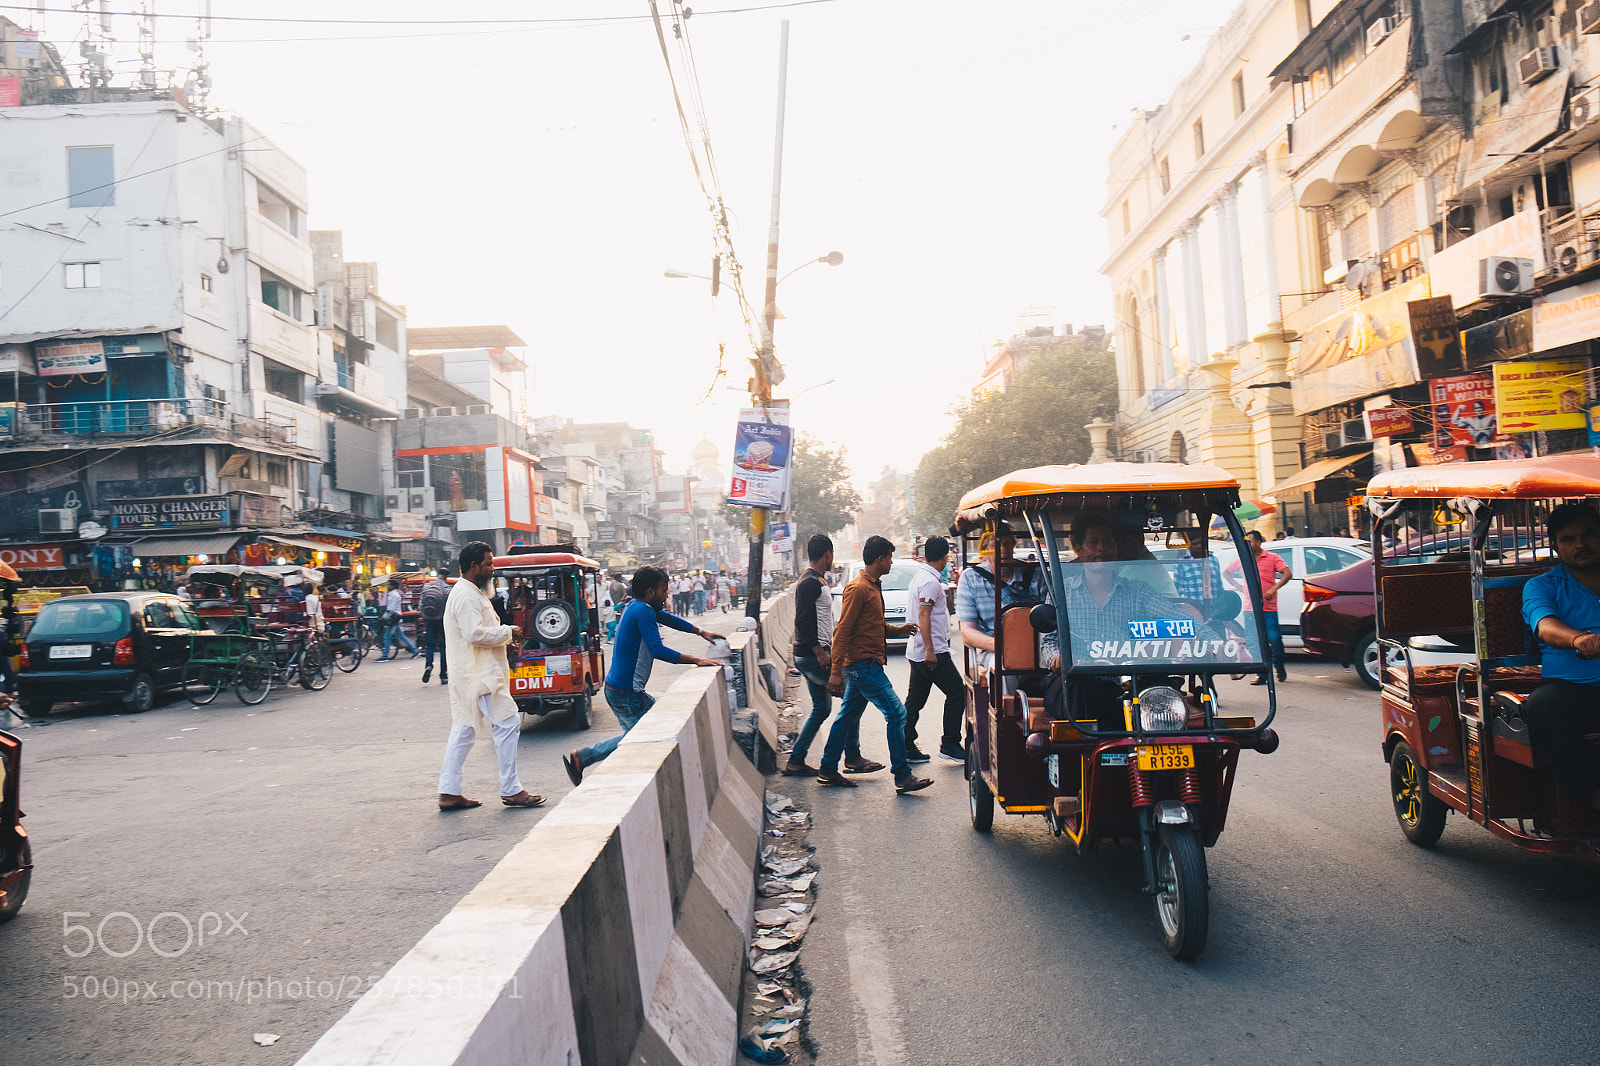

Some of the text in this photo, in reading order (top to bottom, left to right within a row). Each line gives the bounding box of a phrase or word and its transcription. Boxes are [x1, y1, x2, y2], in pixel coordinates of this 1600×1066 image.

[113, 500, 227, 516] MONEY CHANGER
[119, 511, 221, 525] TOURS & TRAVELS
[0, 547, 60, 565] ONY
[1128, 619, 1195, 638] राम राम
[1089, 639, 1239, 659] SHAKTI AUTO
[515, 676, 554, 690] DMW
[1150, 755, 1190, 769] R1339
